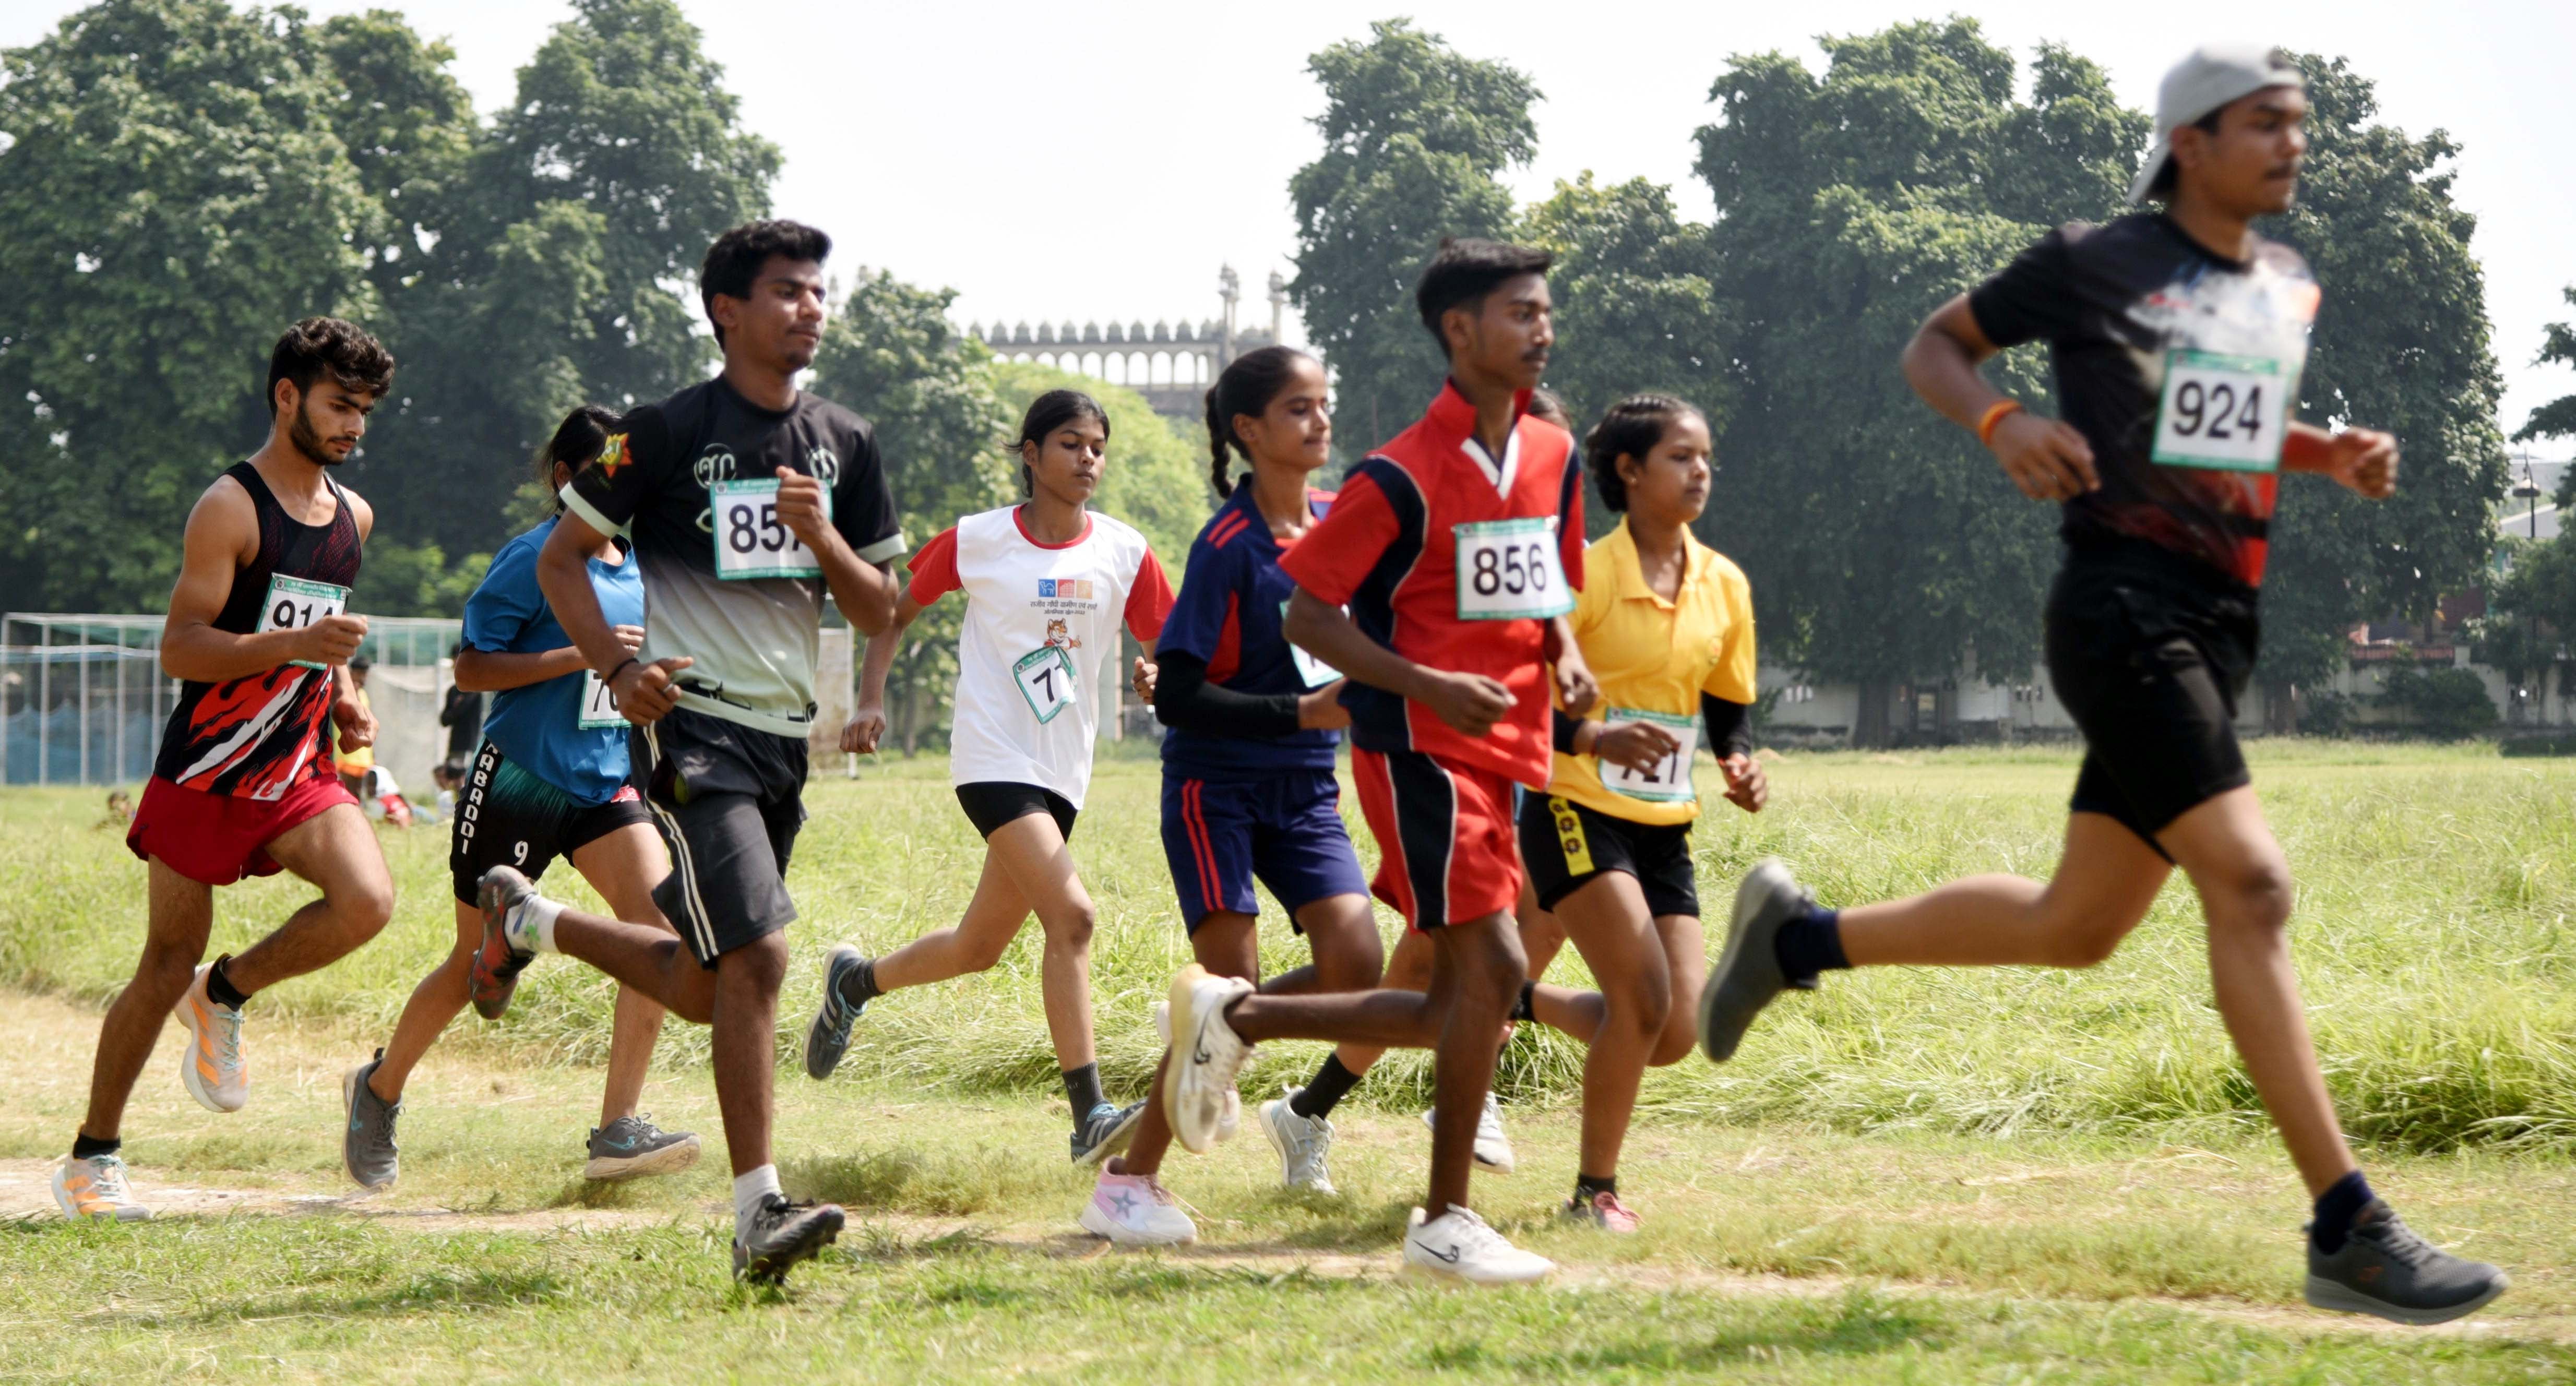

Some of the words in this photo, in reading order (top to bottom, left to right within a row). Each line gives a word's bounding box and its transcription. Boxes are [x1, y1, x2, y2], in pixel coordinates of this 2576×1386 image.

[2172, 379, 2263, 441] 924
[729, 504, 800, 554] 85
[1473, 544, 1546, 596] 856
[272, 600, 333, 629] 91
[514, 840, 529, 866] 9
